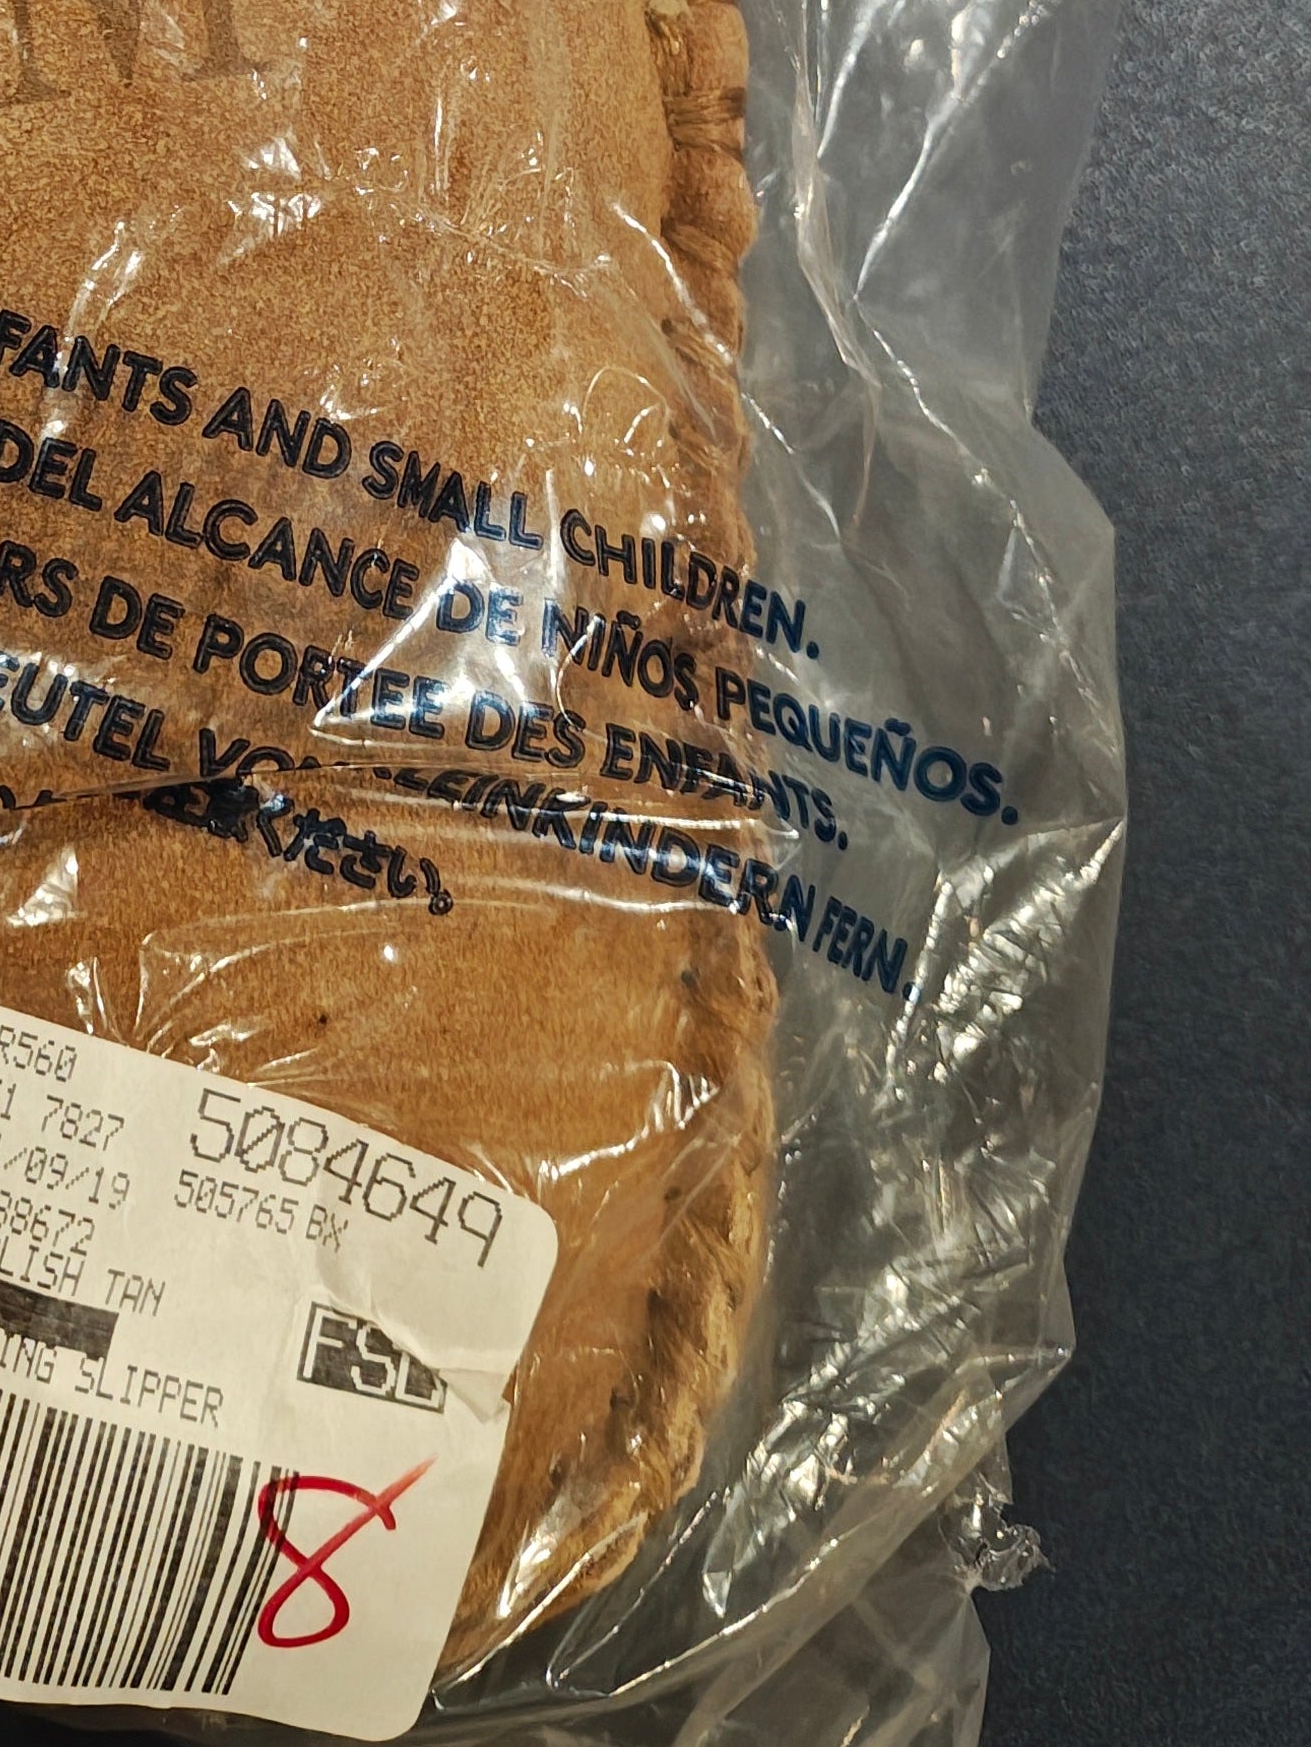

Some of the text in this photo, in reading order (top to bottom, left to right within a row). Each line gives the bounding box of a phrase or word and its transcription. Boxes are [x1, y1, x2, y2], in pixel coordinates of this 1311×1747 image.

[202, 386, 351, 479] AND
[362, 440, 542, 550] SMALL
[560, 508, 820, 660] CHILDREN.
[91, 574, 185, 660] DE
[192, 614, 445, 740] PORTEE
[465, 689, 587, 771] DES
[600, 721, 849, 852] ENFANTS.
[113, 472, 420, 620] ALCANCE
[435, 582, 522, 648] DE
[543, 597, 698, 711] NIÑOS
[716, 667, 1020, 827] PEQUEÑOS.
[811, 896, 915, 1000] FERN.
[40, 1094, 125, 1151] 7827
[190, 1087, 503, 1268] 5084649
[174, 1169, 349, 1252] 505765 BX
[105, 1268, 166, 1317] TAN
[73, 1352, 224, 1428] SLIPPER
[256, 1453, 437, 1649] 8
